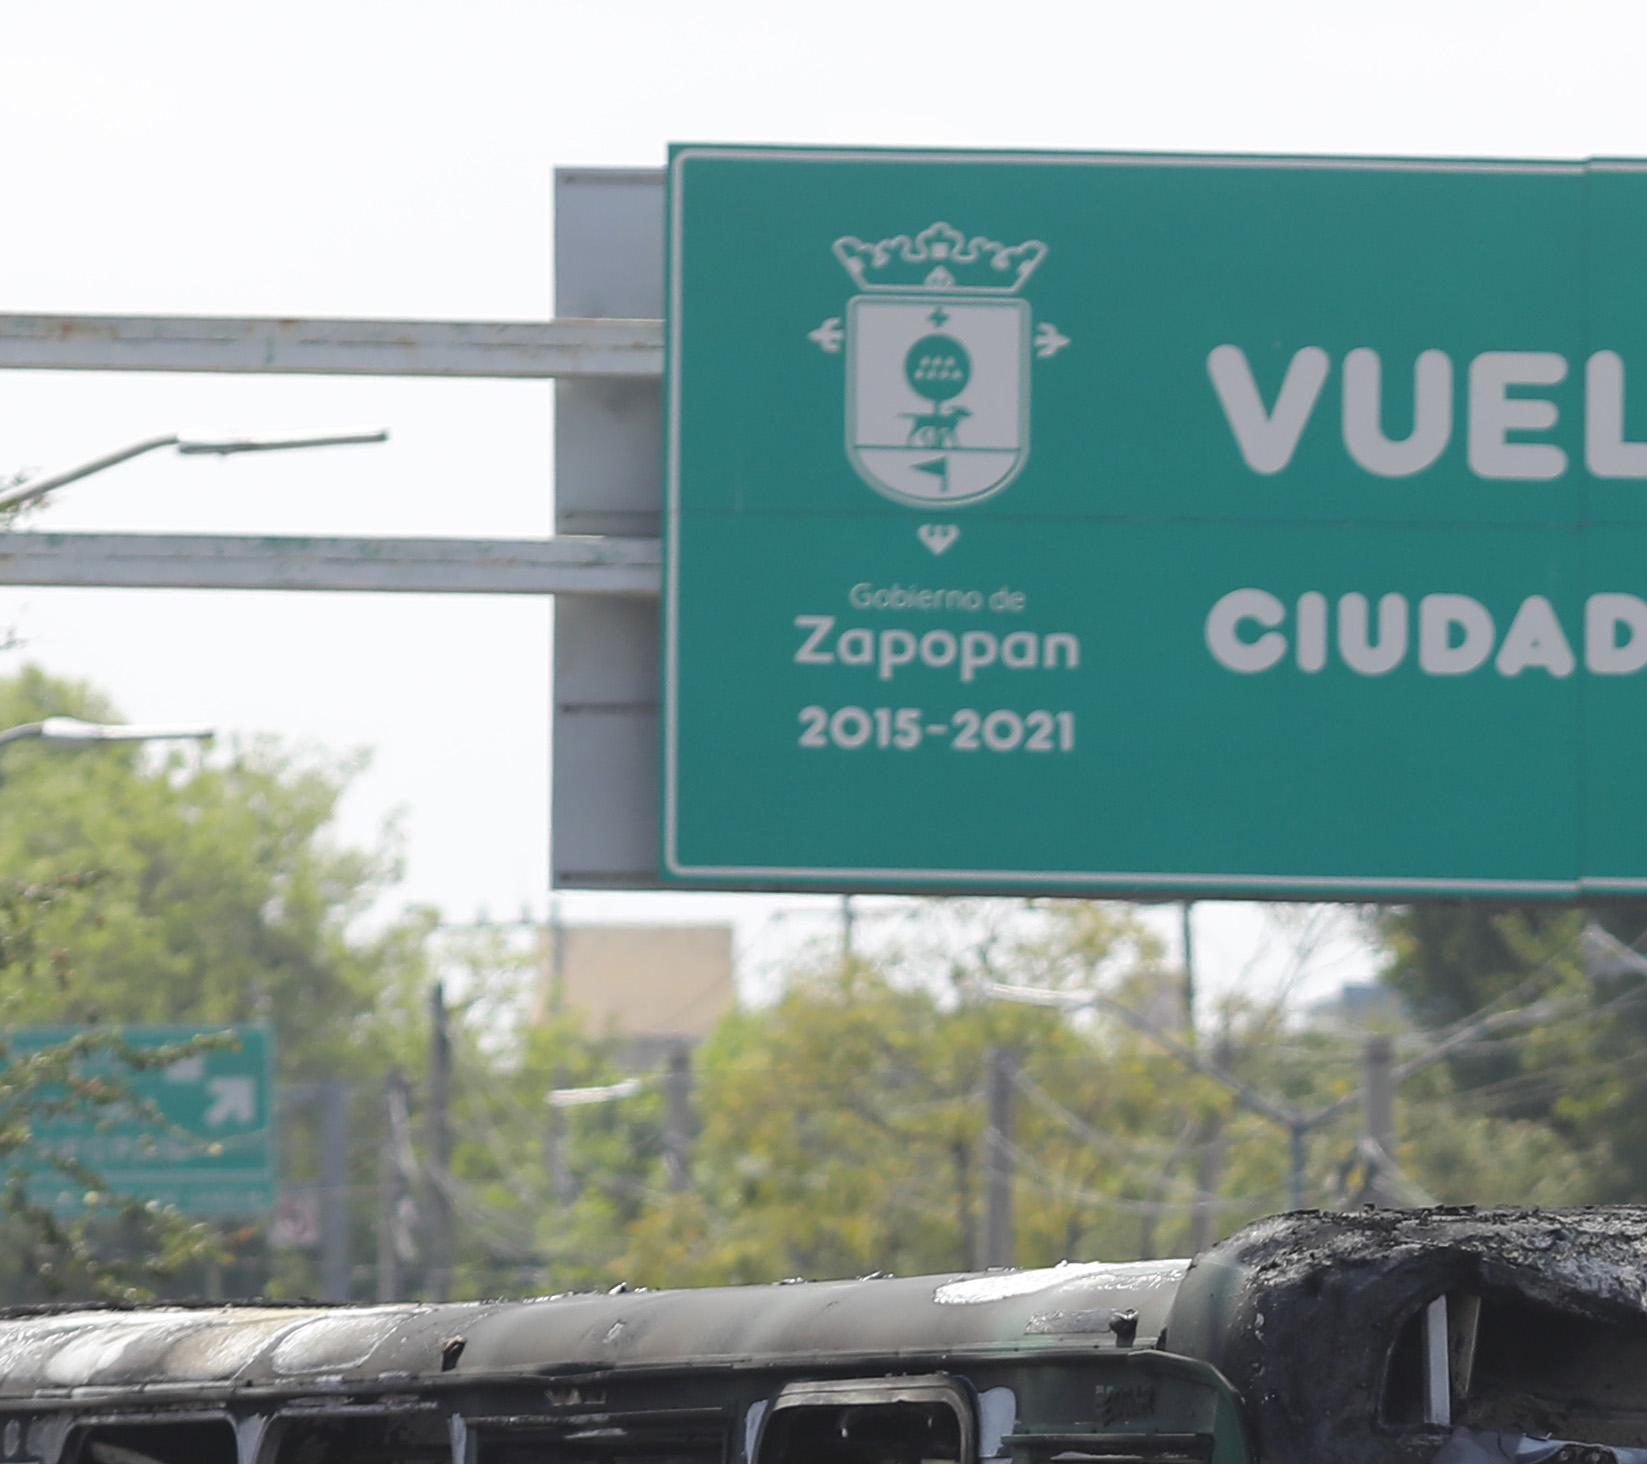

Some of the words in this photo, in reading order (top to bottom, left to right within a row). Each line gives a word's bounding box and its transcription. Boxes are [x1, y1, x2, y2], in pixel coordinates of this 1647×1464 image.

[849, 582, 983, 611] Gobierno
[989, 587, 1025, 611] de
[793, 614, 1080, 683] Zapopan
[798, 705, 1075, 753] 2015-2021
